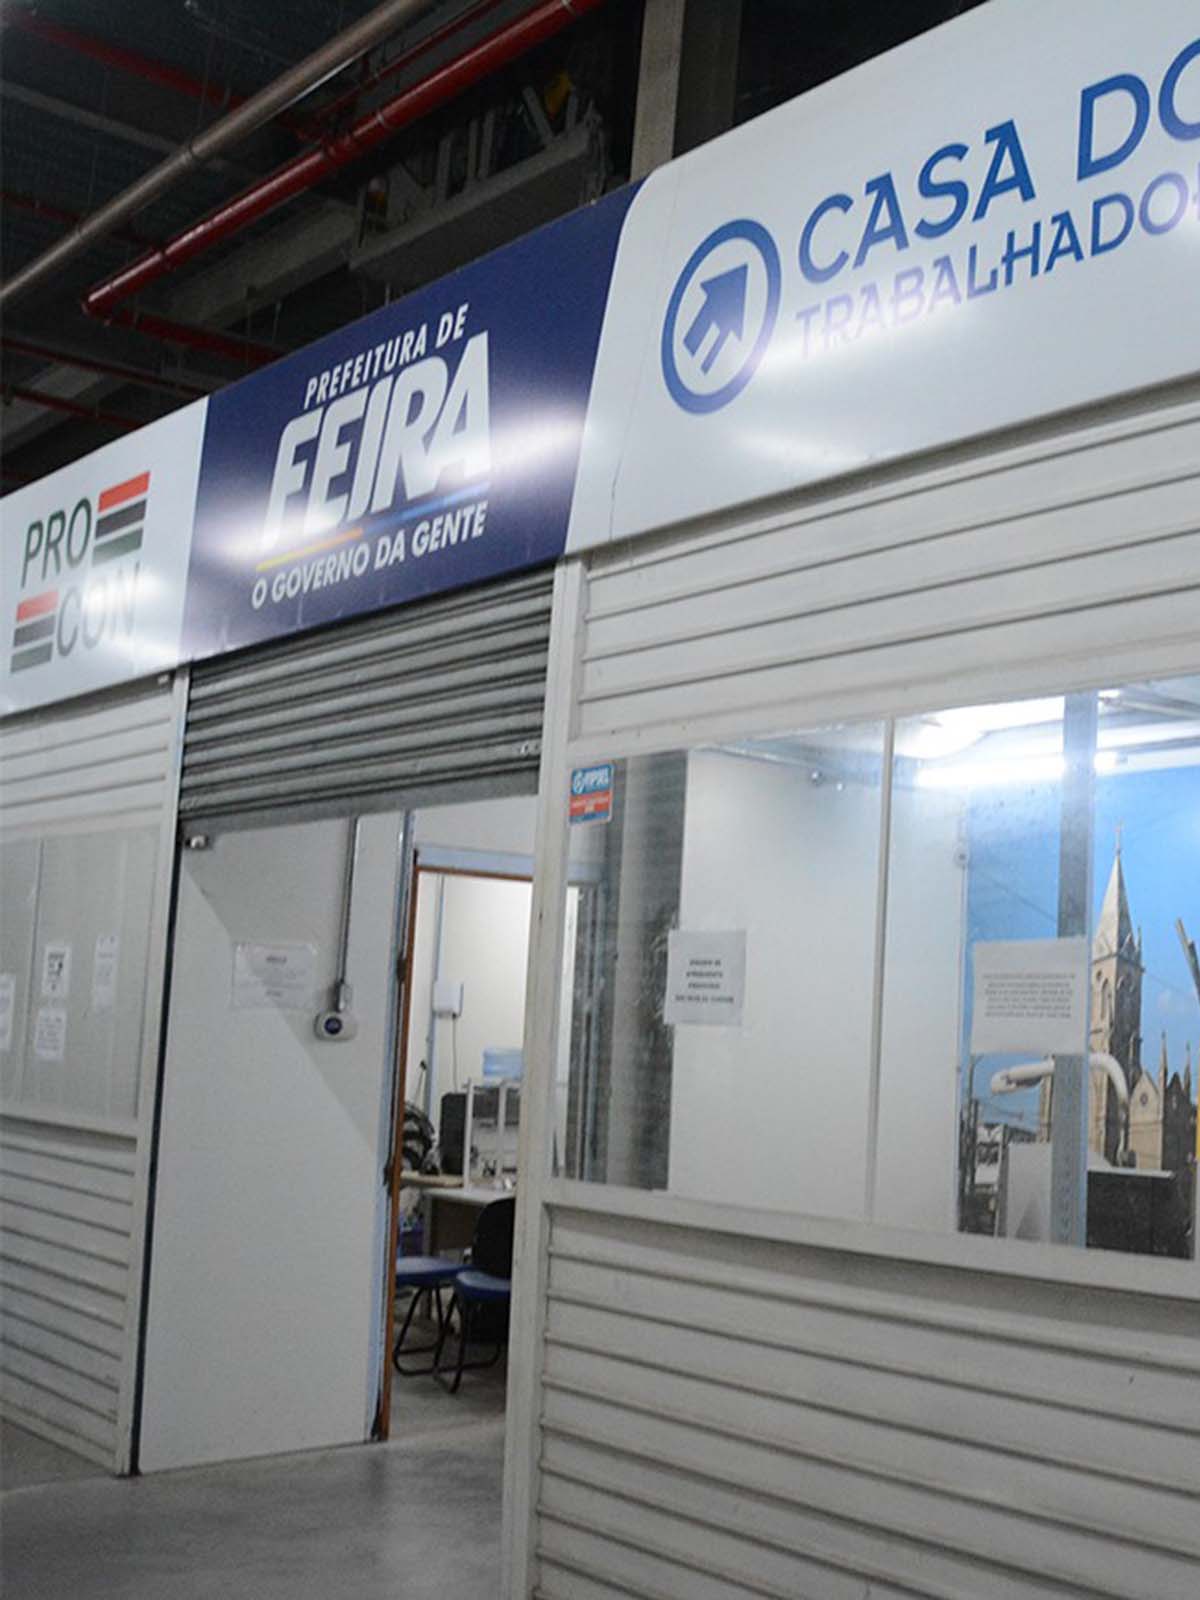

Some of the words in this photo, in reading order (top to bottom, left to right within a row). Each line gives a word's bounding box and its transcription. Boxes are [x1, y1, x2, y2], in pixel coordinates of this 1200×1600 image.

[798, 118, 1036, 284] CASA
[303, 322, 428, 410] PREFEITURA
[435, 303, 469, 349] DE
[262, 331, 493, 550] FEIRA
[20, 497, 92, 590] PRO
[251, 577, 267, 610] O
[271, 543, 370, 604] GOVERNO
[374, 528, 405, 571] DA
[411, 500, 489, 558] GENTE
[56, 560, 141, 657] CON
